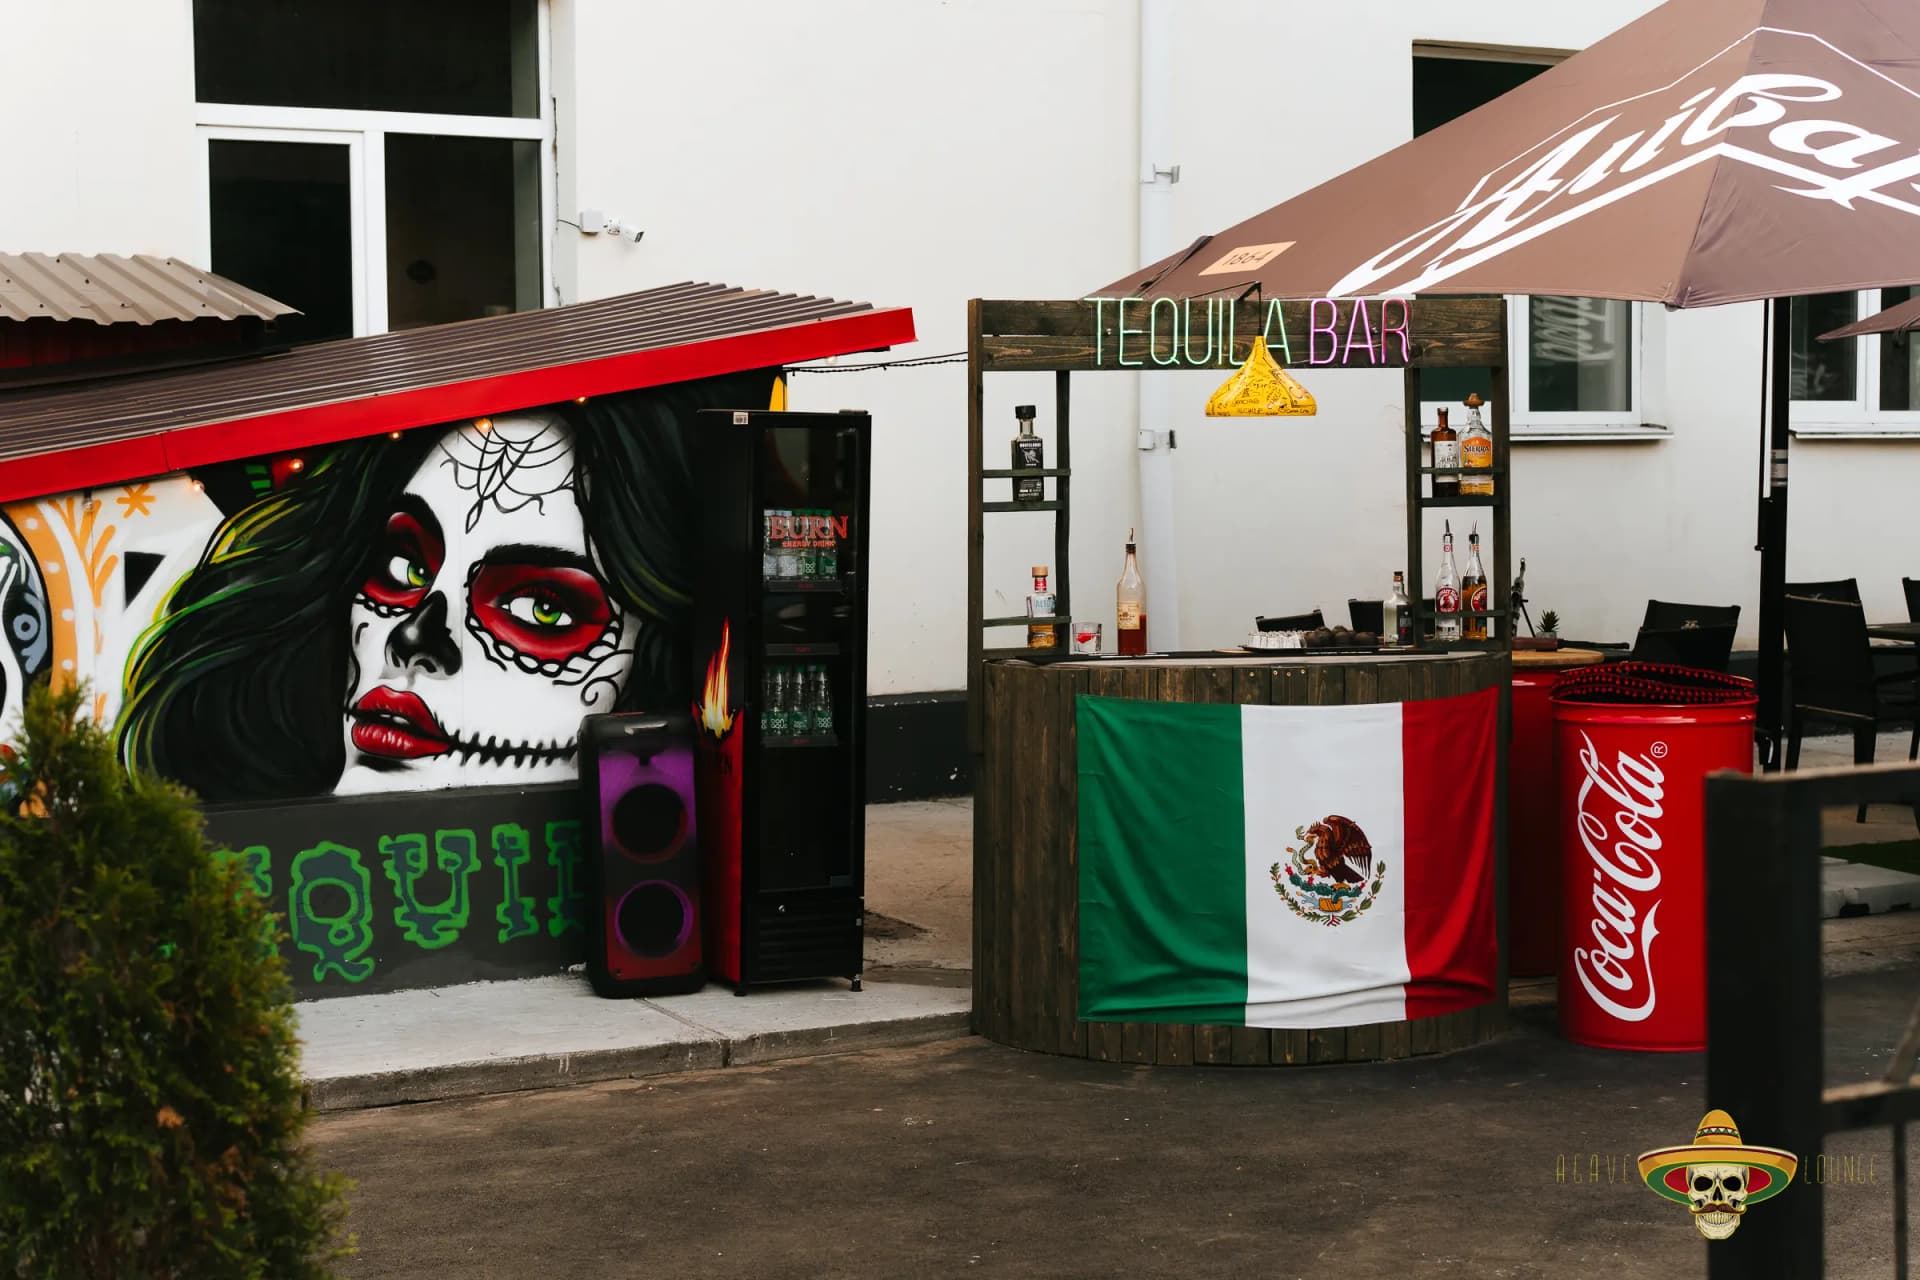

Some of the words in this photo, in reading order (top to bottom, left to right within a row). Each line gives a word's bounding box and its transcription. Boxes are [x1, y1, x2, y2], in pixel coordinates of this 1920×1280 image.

[1222, 249, 1273, 267] 1864
[1083, 297, 1291, 366] TEQUILA
[1309, 297, 1410, 365] BAR
[769, 515, 849, 540] BURN
